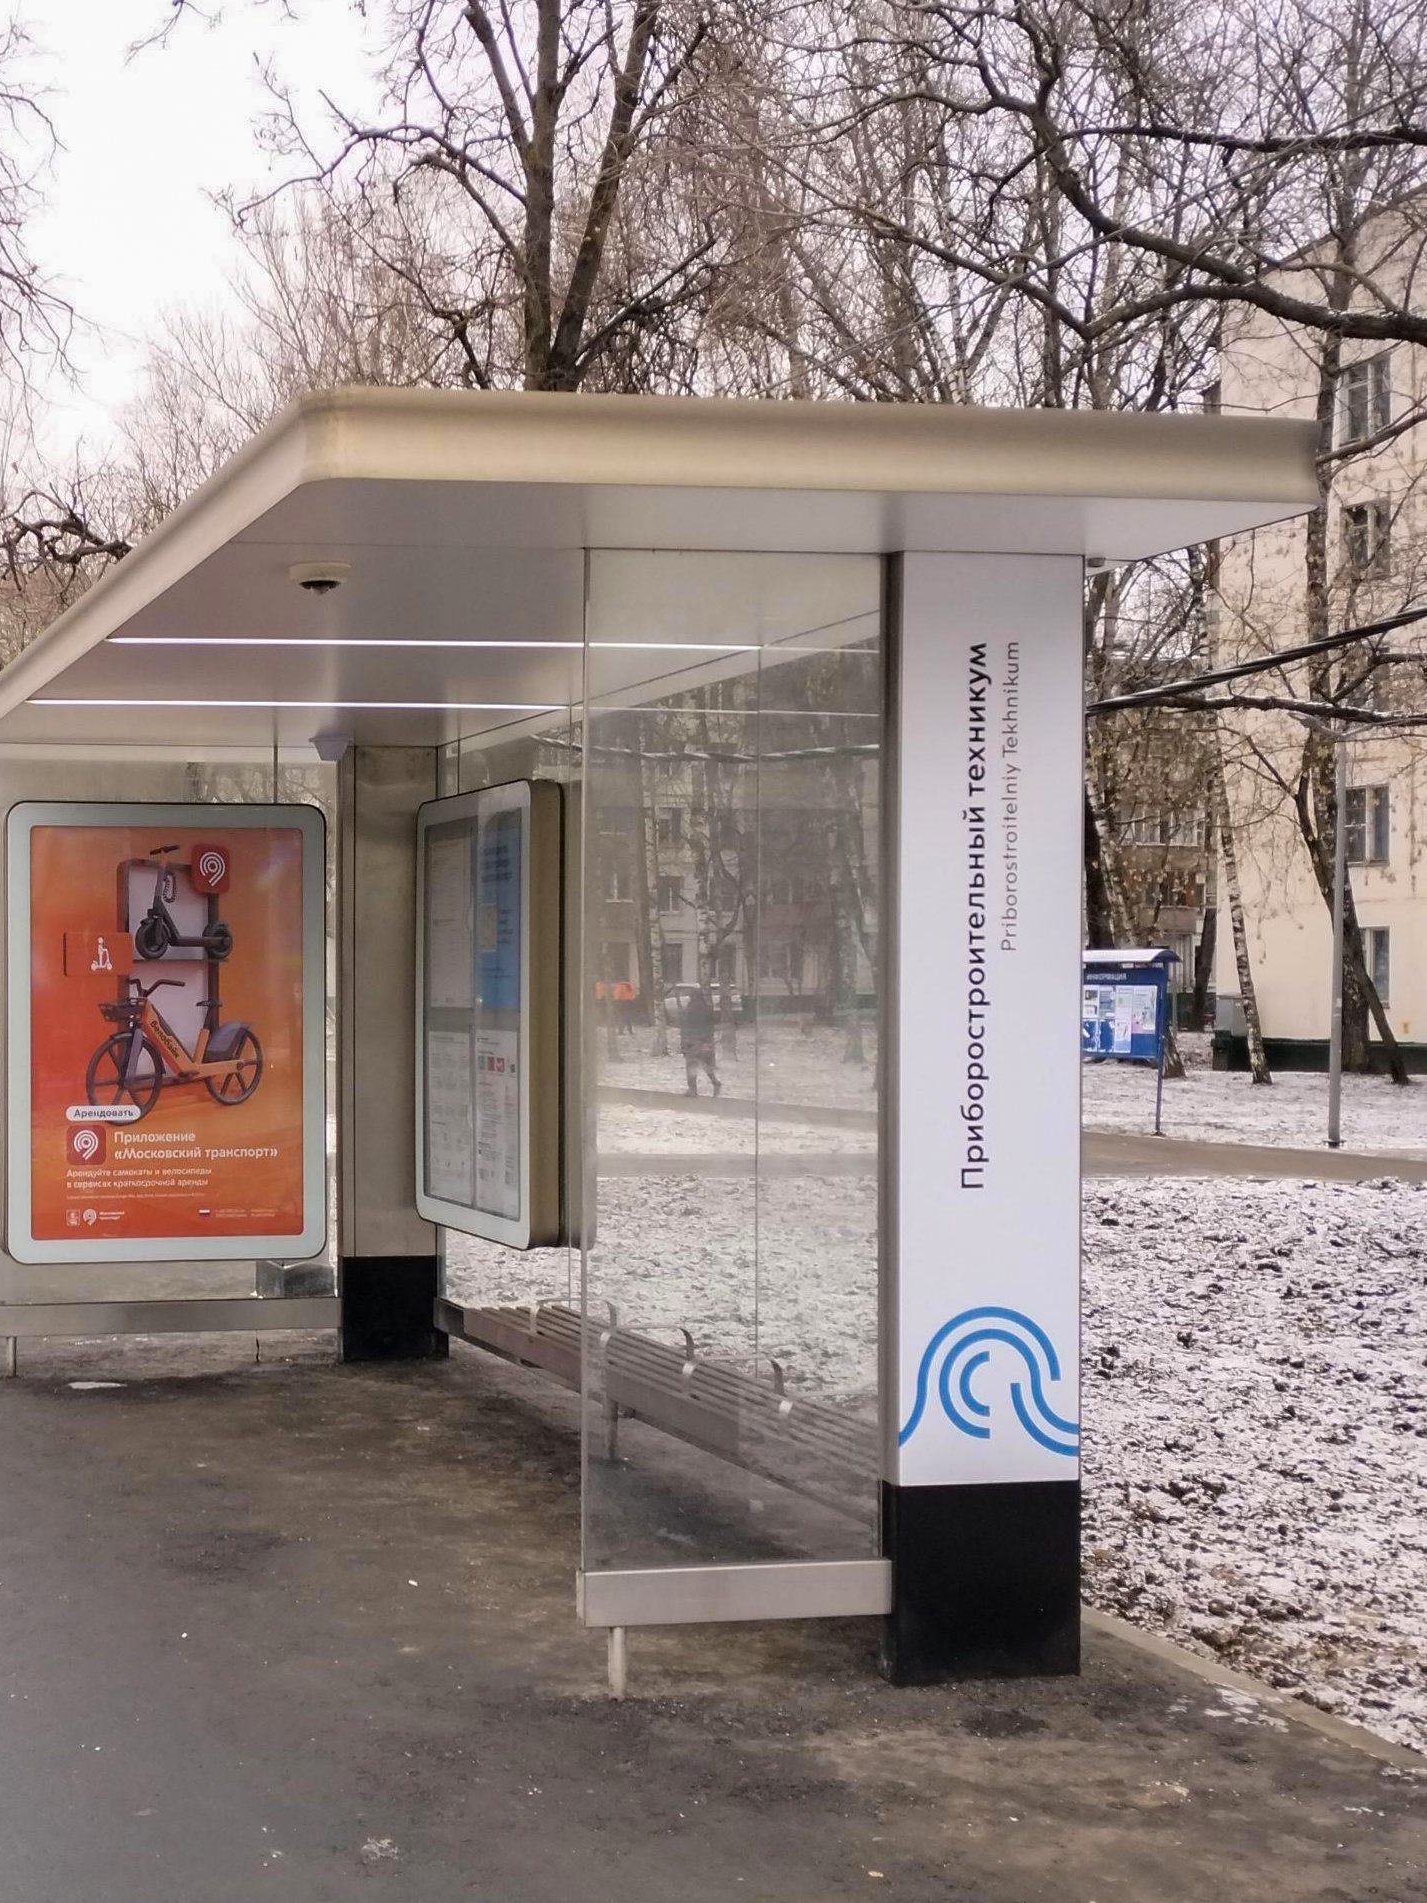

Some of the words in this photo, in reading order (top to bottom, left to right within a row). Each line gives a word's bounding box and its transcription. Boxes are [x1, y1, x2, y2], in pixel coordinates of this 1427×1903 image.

[969, 643, 992, 797] техникум
[1002, 641, 1020, 758] Tekhnikum
[1000, 762, 1021, 952] Priborostroitelniy
[960, 807, 991, 1189] Приборостроительный
[74, 1108, 134, 1118] Арендовать
[114, 1131, 196, 1145] Приложение
[66, 1168, 111, 1179] Арендуйте
[113, 1168, 153, 1177] самокаты
[154, 1168, 160, 1176] и
[114, 1147, 202, 1160] «Московский
[204, 1148, 278, 1160] транспорт»
